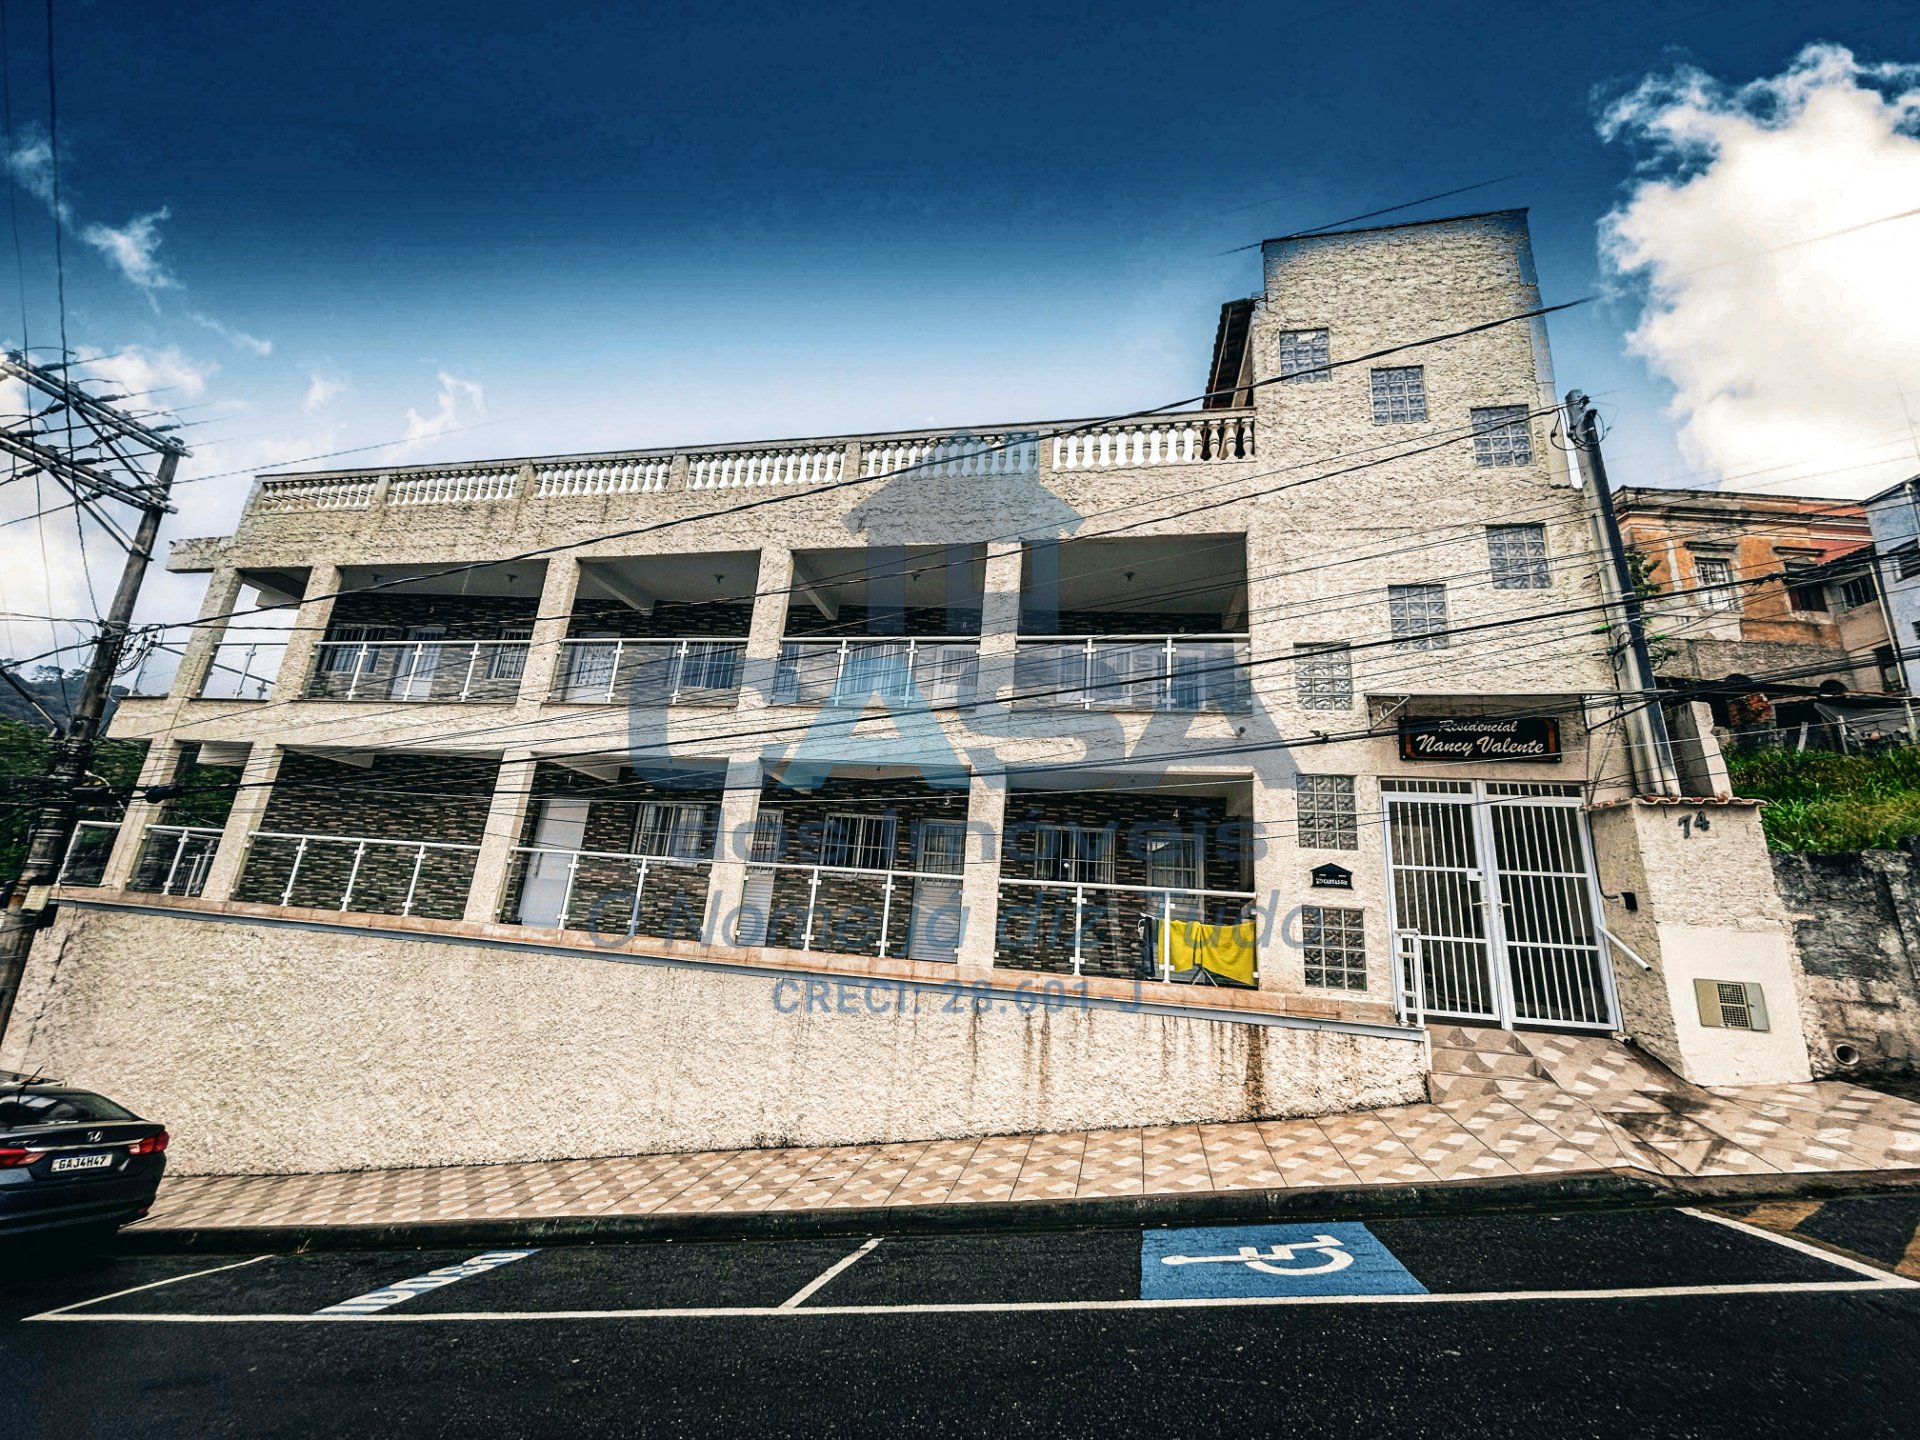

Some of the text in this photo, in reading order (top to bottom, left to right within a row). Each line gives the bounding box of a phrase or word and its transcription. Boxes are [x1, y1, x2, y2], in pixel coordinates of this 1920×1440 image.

[1438, 719, 1518, 733] Residencial
[1416, 734, 1545, 757] Nancy Valente
[58, 1155, 107, 1170] GAJ4H47
